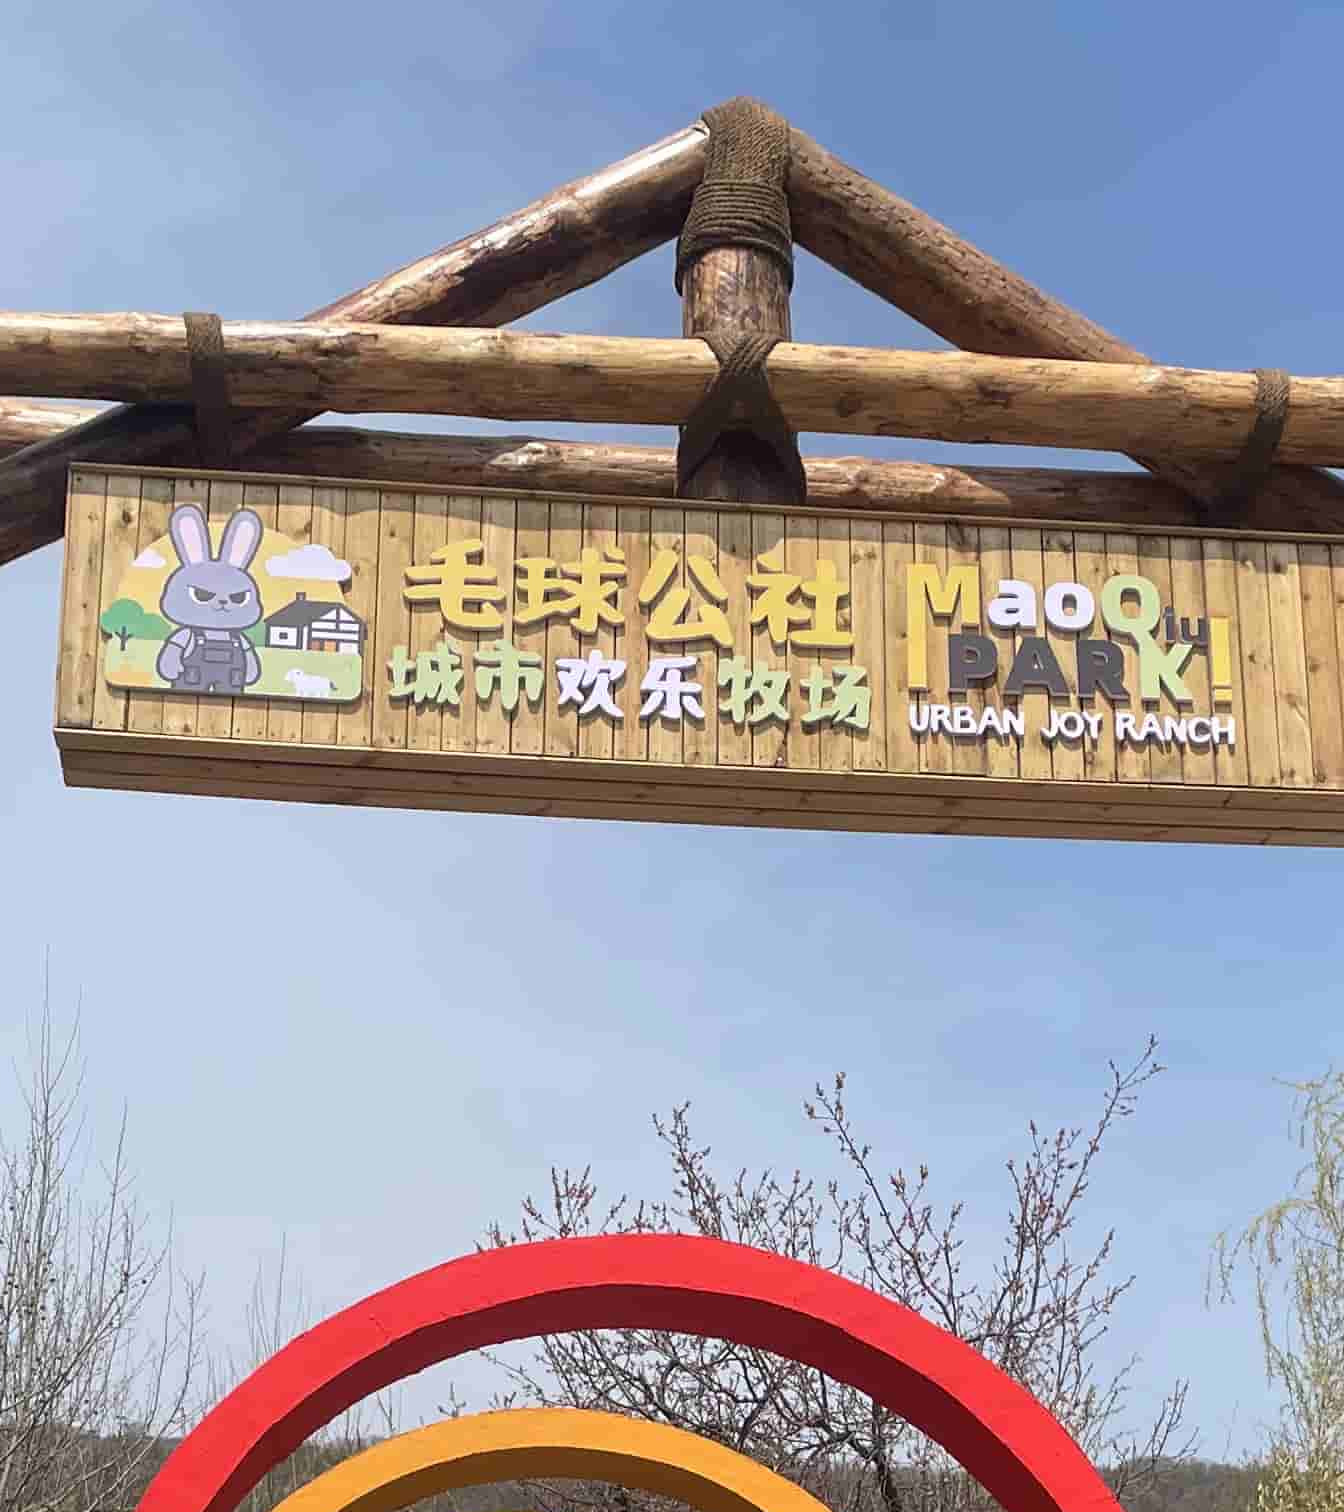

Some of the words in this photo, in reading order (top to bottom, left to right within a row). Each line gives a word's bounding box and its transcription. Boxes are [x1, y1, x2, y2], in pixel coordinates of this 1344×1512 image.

[403, 539, 857, 648] 毛球公社
[388, 640, 873, 730] 城市欢乐牧场
[908, 703, 1025, 738] URBAN
[1040, 709, 1103, 742] JOY
[1114, 711, 1237, 747] RANCH
